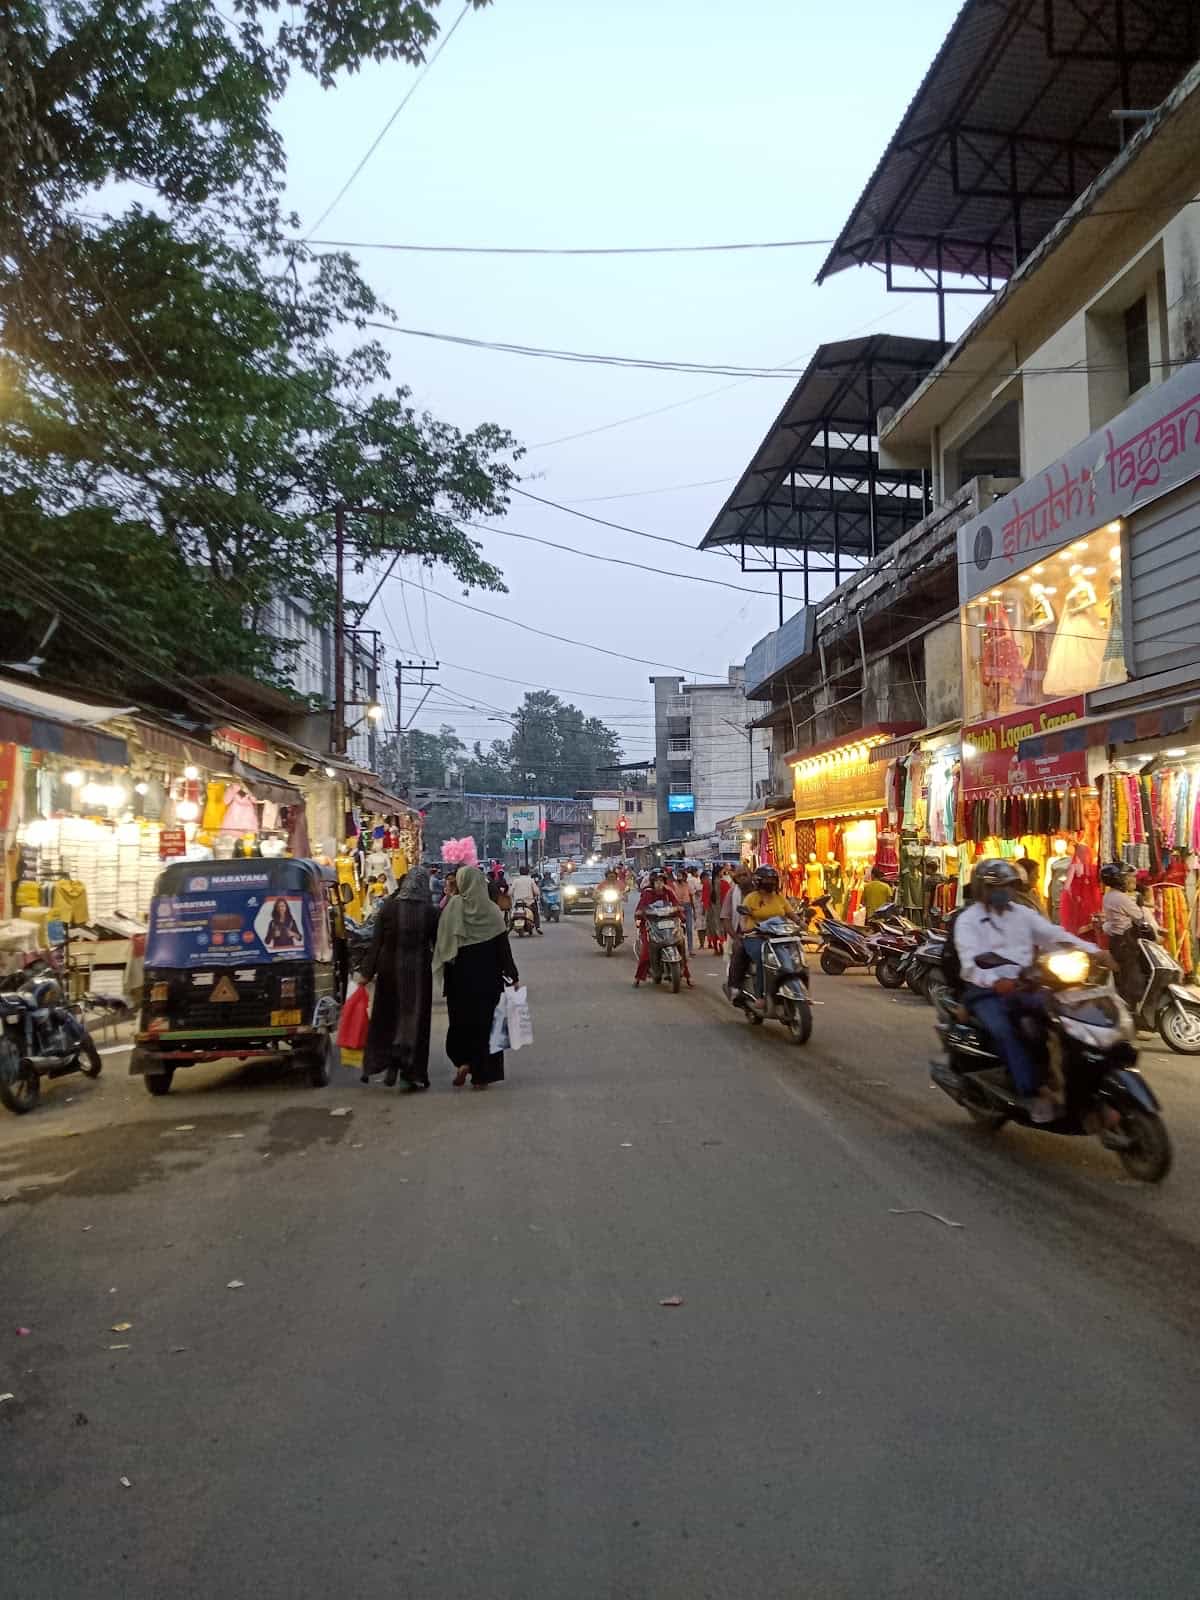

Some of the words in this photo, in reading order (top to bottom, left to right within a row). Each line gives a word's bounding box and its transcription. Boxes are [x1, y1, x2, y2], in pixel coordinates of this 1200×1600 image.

[966, 727, 997, 753] Shubh
[1000, 723, 1034, 752] Lagan
[211, 873, 269, 884] NARAYANA
